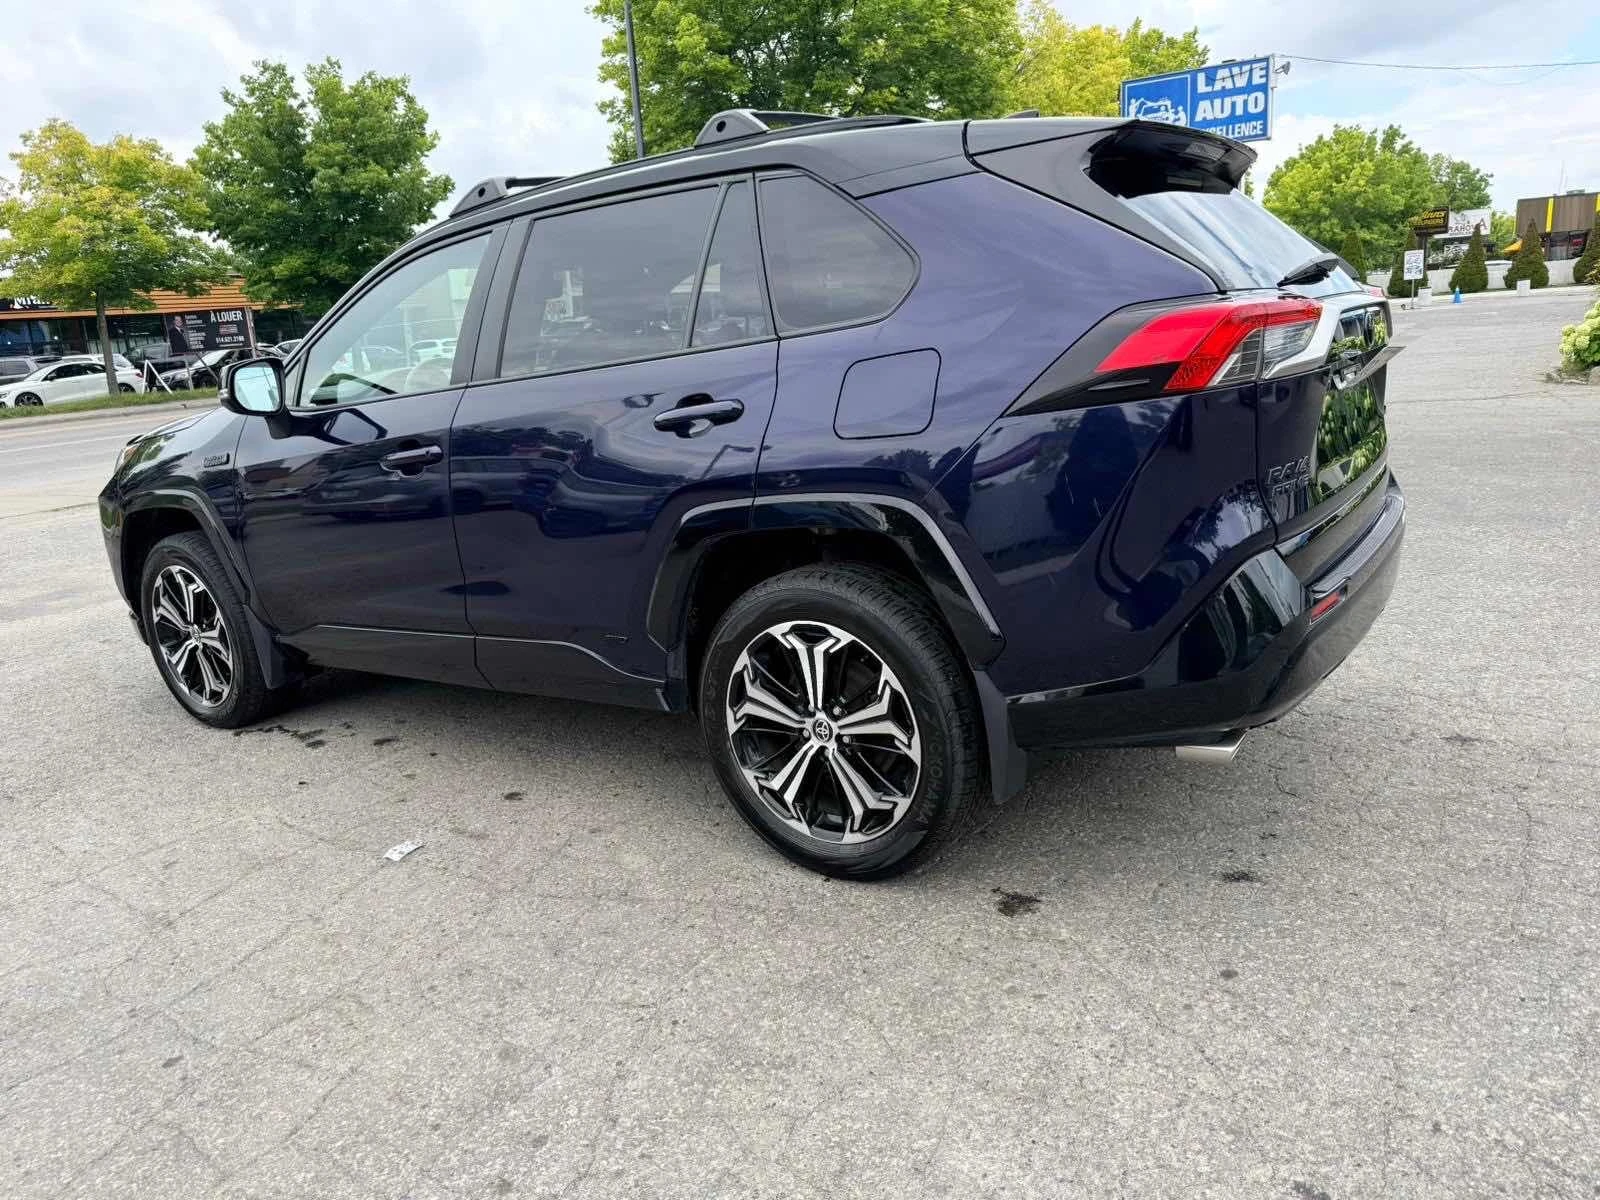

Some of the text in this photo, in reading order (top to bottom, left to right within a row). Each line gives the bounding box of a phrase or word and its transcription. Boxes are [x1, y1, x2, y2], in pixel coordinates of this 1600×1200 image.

[1197, 61, 1267, 93] LAVE
[1194, 91, 1265, 122] AUTO
[1201, 120, 1263, 137] CELLENCE
[210, 310, 216, 323] À
[217, 310, 243, 323] LOUER
